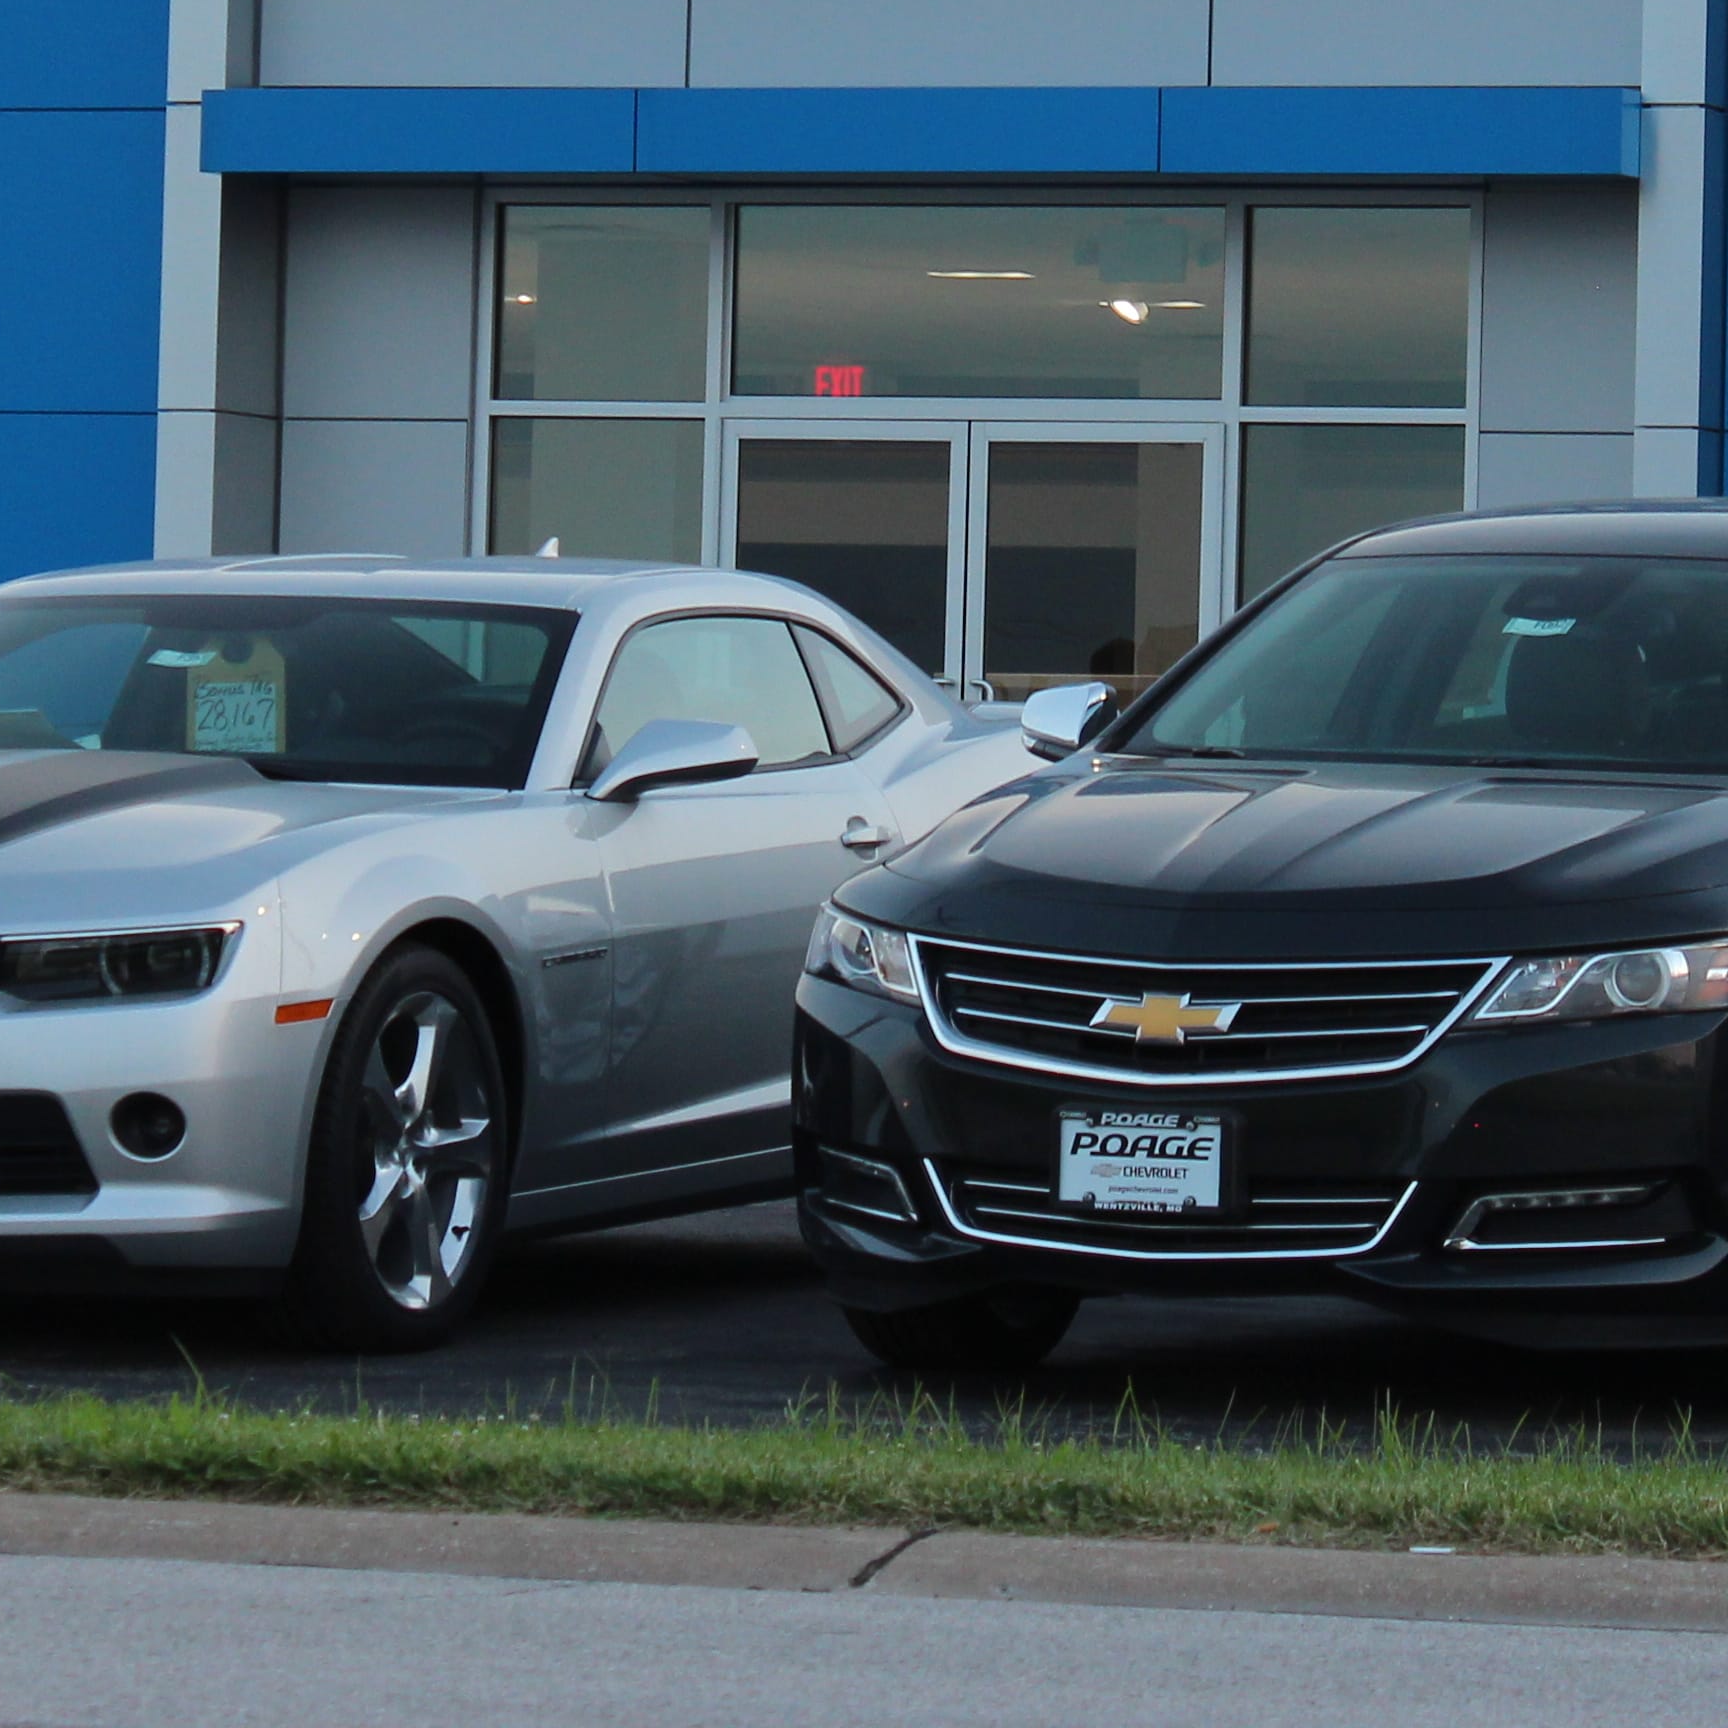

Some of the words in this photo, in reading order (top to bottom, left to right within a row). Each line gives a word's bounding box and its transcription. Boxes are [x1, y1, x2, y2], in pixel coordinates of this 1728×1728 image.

[815, 365, 865, 397] EXIT
[1101, 1111, 1180, 1128] POAGE
[1070, 1132, 1215, 1161] POAGE
[1123, 1166, 1189, 1180] CHEVROLET
